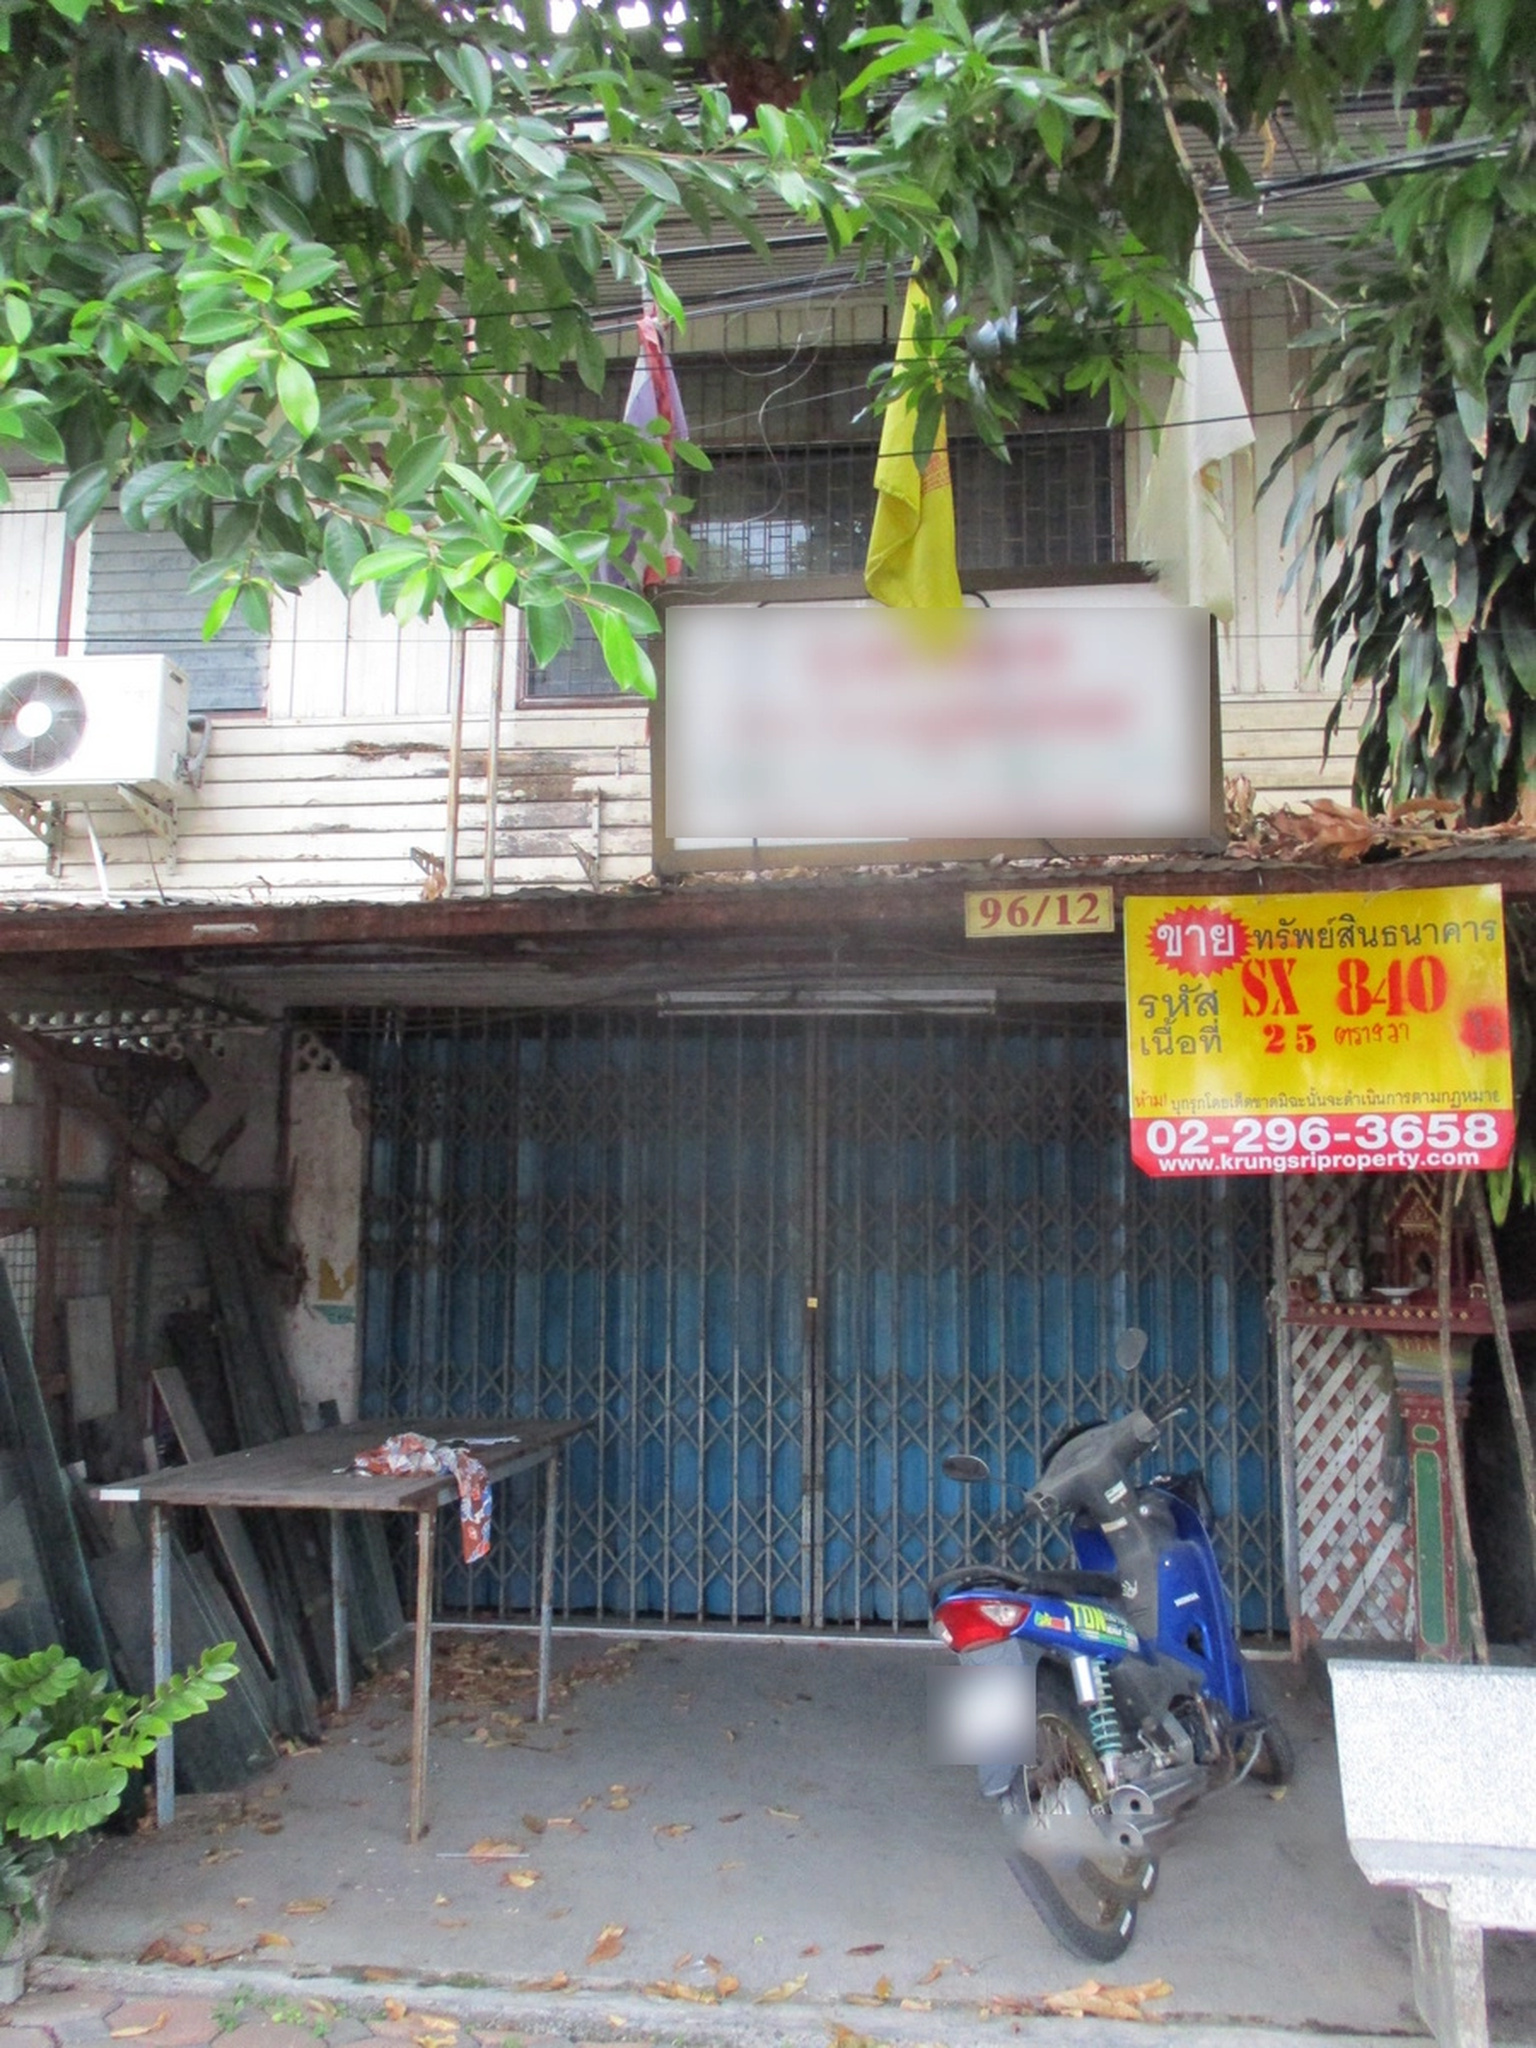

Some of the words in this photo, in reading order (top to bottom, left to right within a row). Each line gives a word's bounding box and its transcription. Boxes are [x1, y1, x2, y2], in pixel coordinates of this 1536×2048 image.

[979, 892, 1100, 929] 96/12
[1157, 921, 1234, 957] ขาย
[1253, 913, 1497, 950] ทรัพย์สินธนาคาร
[1138, 984, 1219, 1018] รหัส
[1242, 957, 1299, 1018] SX
[1336, 954, 1448, 1016] 840
[1140, 1017, 1222, 1056] เนื้อที่
[1134, 1090, 1167, 1107] ห้าม!
[1146, 1113, 1498, 1154] 02-296-3658
[1158, 1150, 1480, 1173] www.krungsriproperty.com
